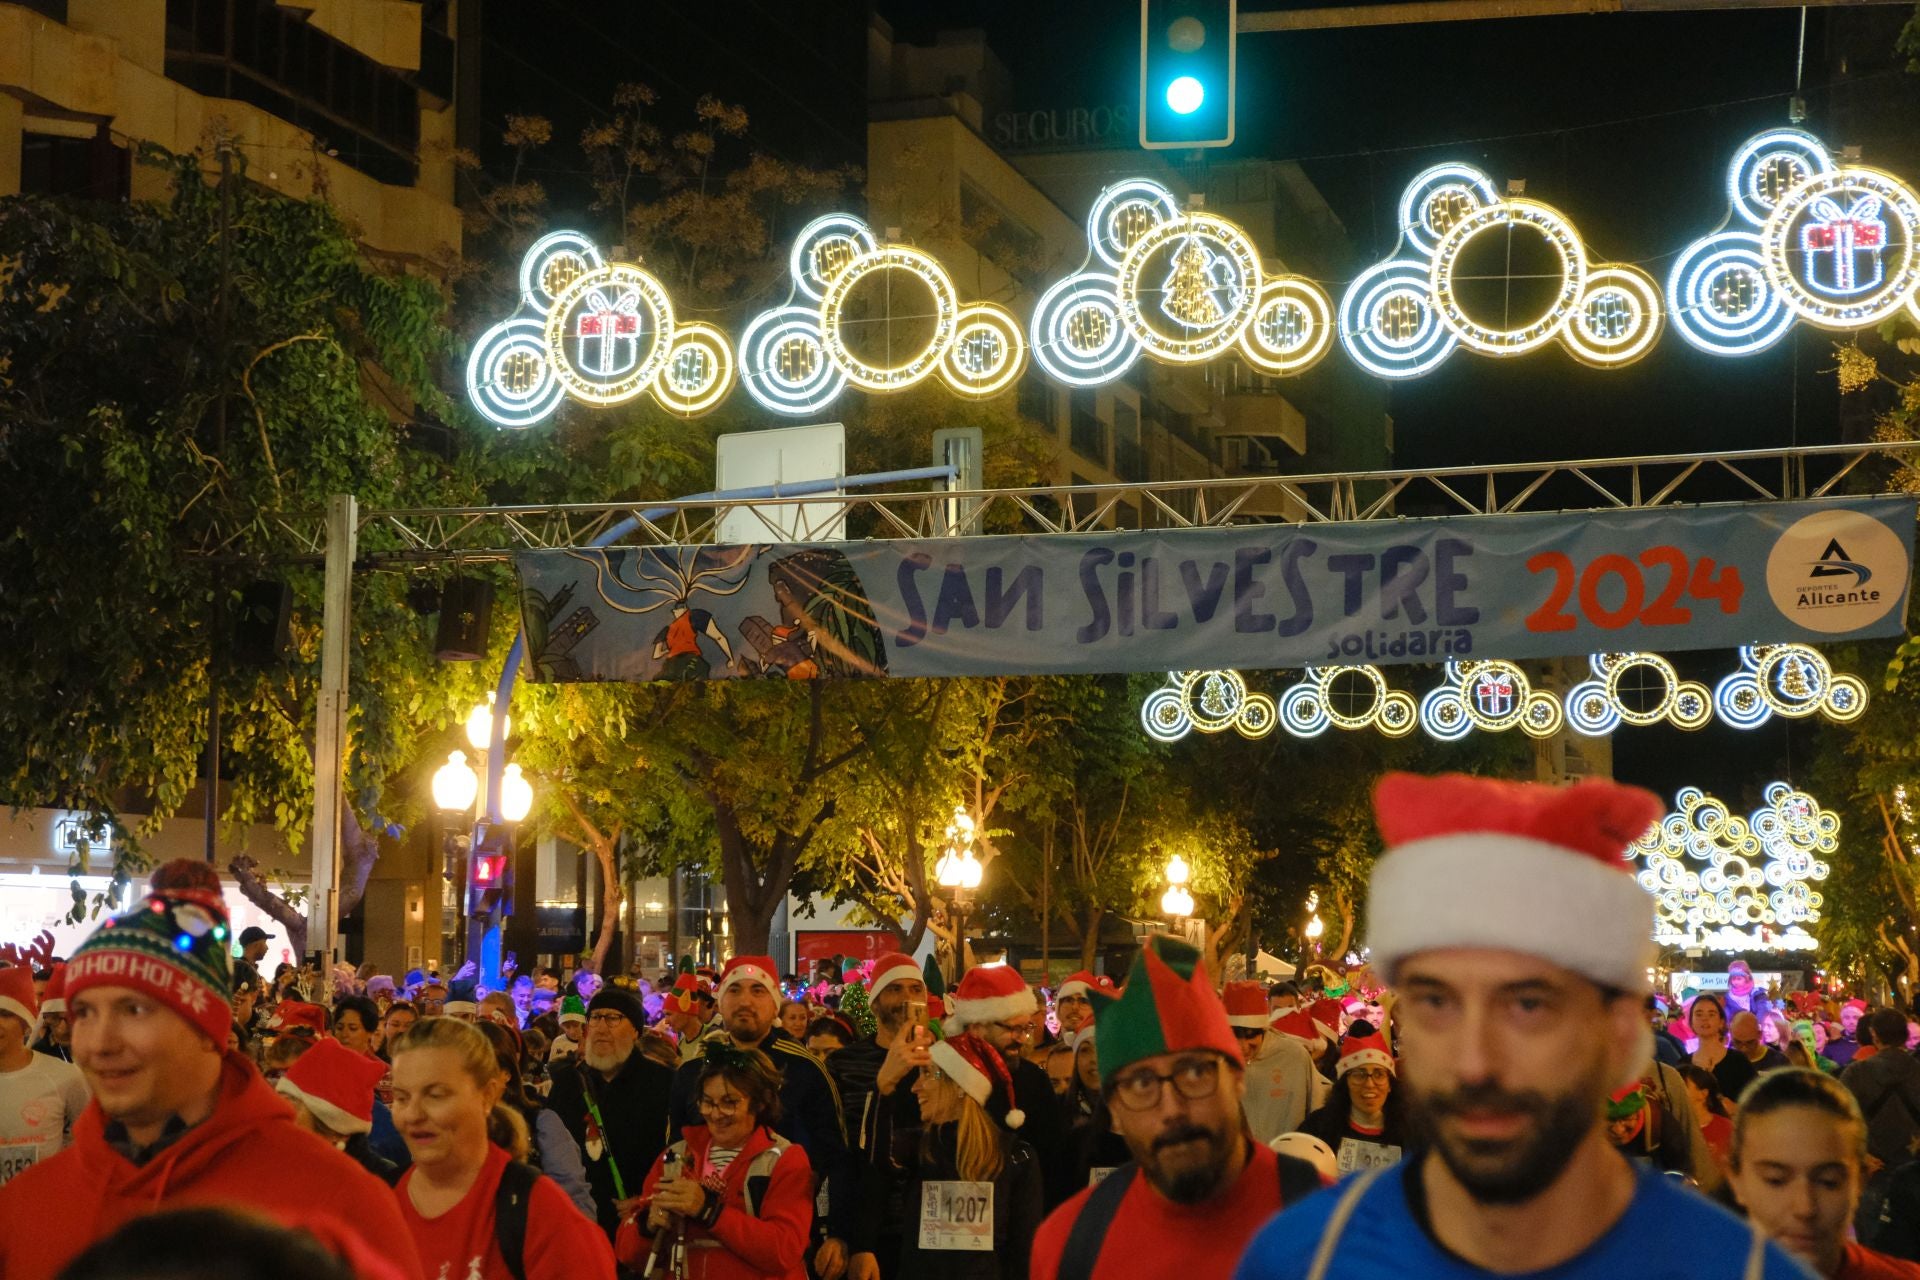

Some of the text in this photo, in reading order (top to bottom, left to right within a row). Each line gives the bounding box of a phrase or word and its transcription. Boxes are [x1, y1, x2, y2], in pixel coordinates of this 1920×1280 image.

[994, 104, 1130, 144] SEGUROS
[895, 552, 1044, 648] SAN
[1524, 545, 1745, 633] 2024
[1796, 584, 1839, 593] DEPORTES
[1797, 589, 1880, 606] Alicante
[85, 954, 128, 976] HO!
[128, 956, 174, 989] HO!
[945, 1196, 987, 1223] 1207
